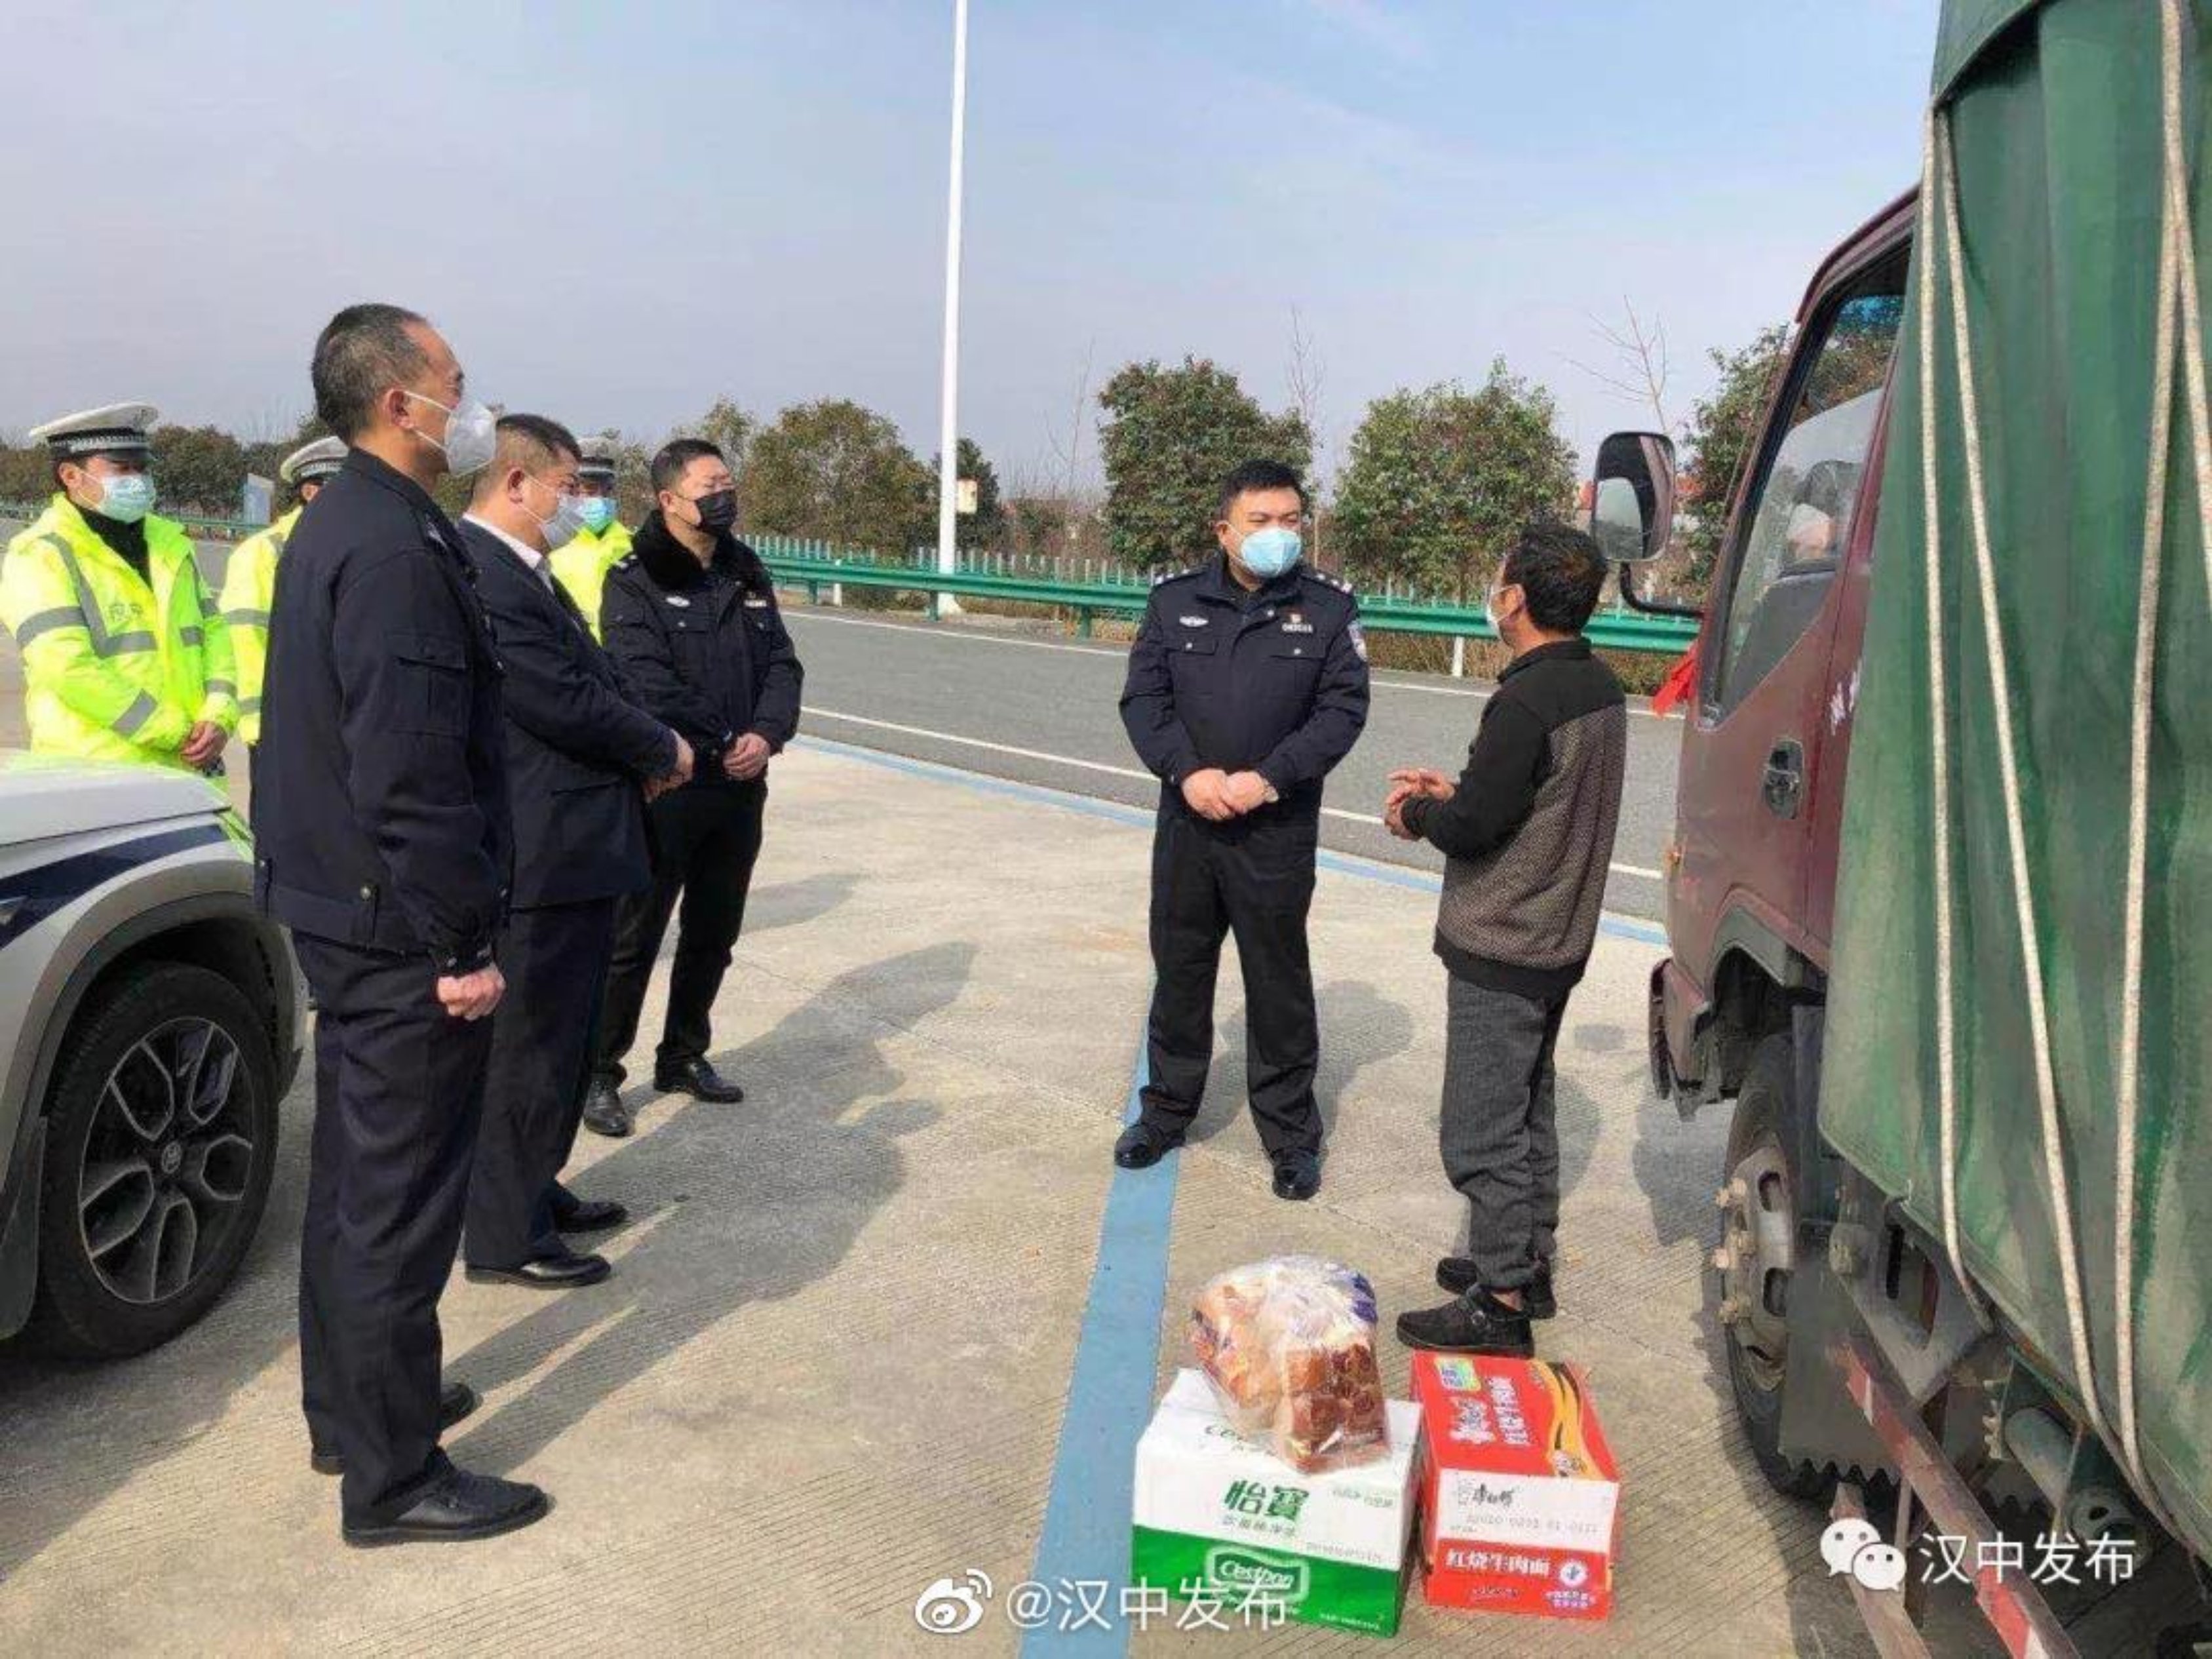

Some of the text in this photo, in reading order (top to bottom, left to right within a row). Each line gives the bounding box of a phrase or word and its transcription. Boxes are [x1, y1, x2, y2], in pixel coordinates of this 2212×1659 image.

[1224, 1479, 1310, 1521] 怡寶
[1446, 1549, 1551, 1577] 红烧牛肉面
